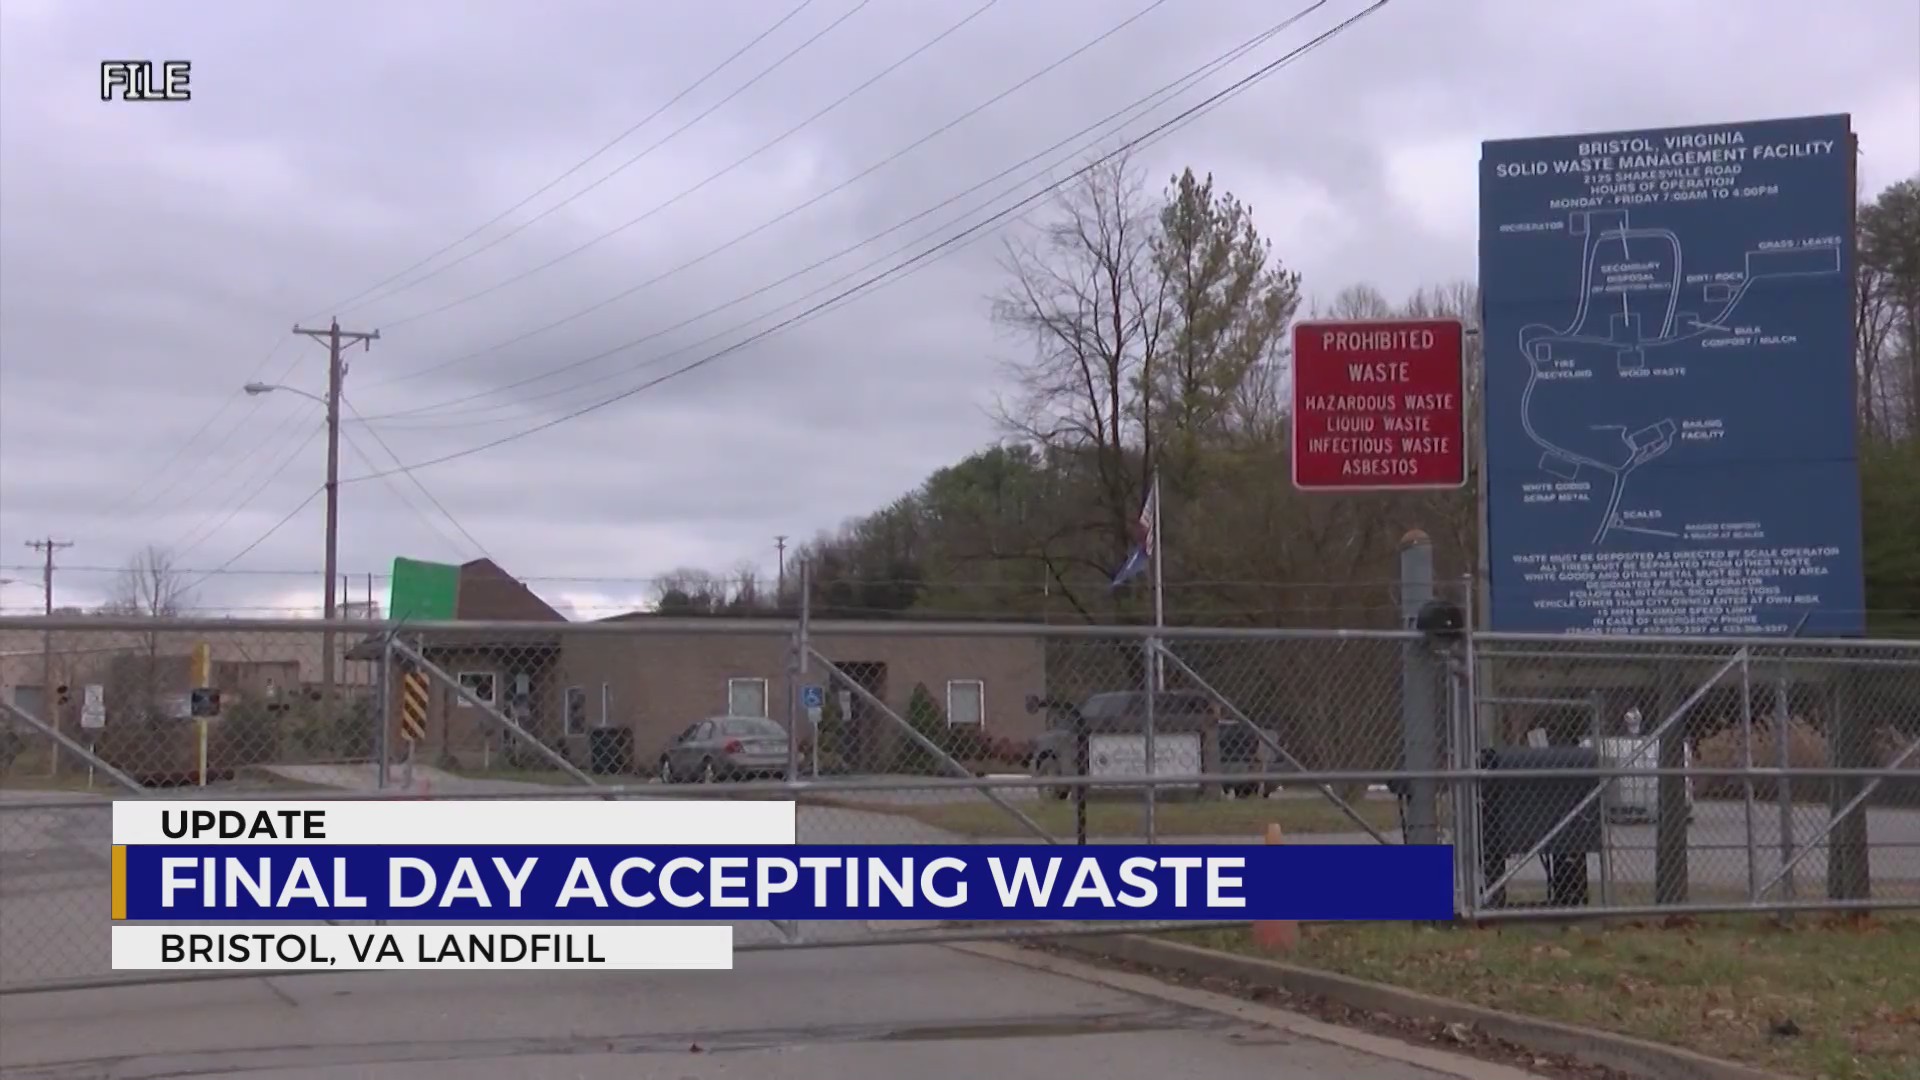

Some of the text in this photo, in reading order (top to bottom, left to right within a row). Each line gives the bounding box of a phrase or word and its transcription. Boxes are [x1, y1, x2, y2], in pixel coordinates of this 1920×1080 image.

[1579, 131, 1744, 156] BRISTOL, VIRGINIA
[1496, 140, 1833, 177] SOLID WASTE MANAGEMENT FACILITY
[1616, 166, 1701, 182] SHAKESVILLE
[1705, 163, 1742, 175] ROAD
[1591, 177, 1735, 195] HOURS OF OPERATION
[1550, 197, 1603, 209] MONDAY
[1615, 193, 1659, 205] FRIDAY
[1712, 188, 1729, 199] TO
[1323, 330, 1434, 351] PROHIBITED
[1349, 362, 1410, 382] WASTE
[1305, 394, 1454, 411] HAZARDOUS WASTE
[1327, 416, 1431, 432] LIQUID WASTE
[1309, 437, 1449, 454] INFECTIOUS WASTE
[1342, 459, 1418, 475] ASBESTOS
[1744, 549, 1778, 558] SCALE
[1781, 546, 1840, 557] OPERATOR
